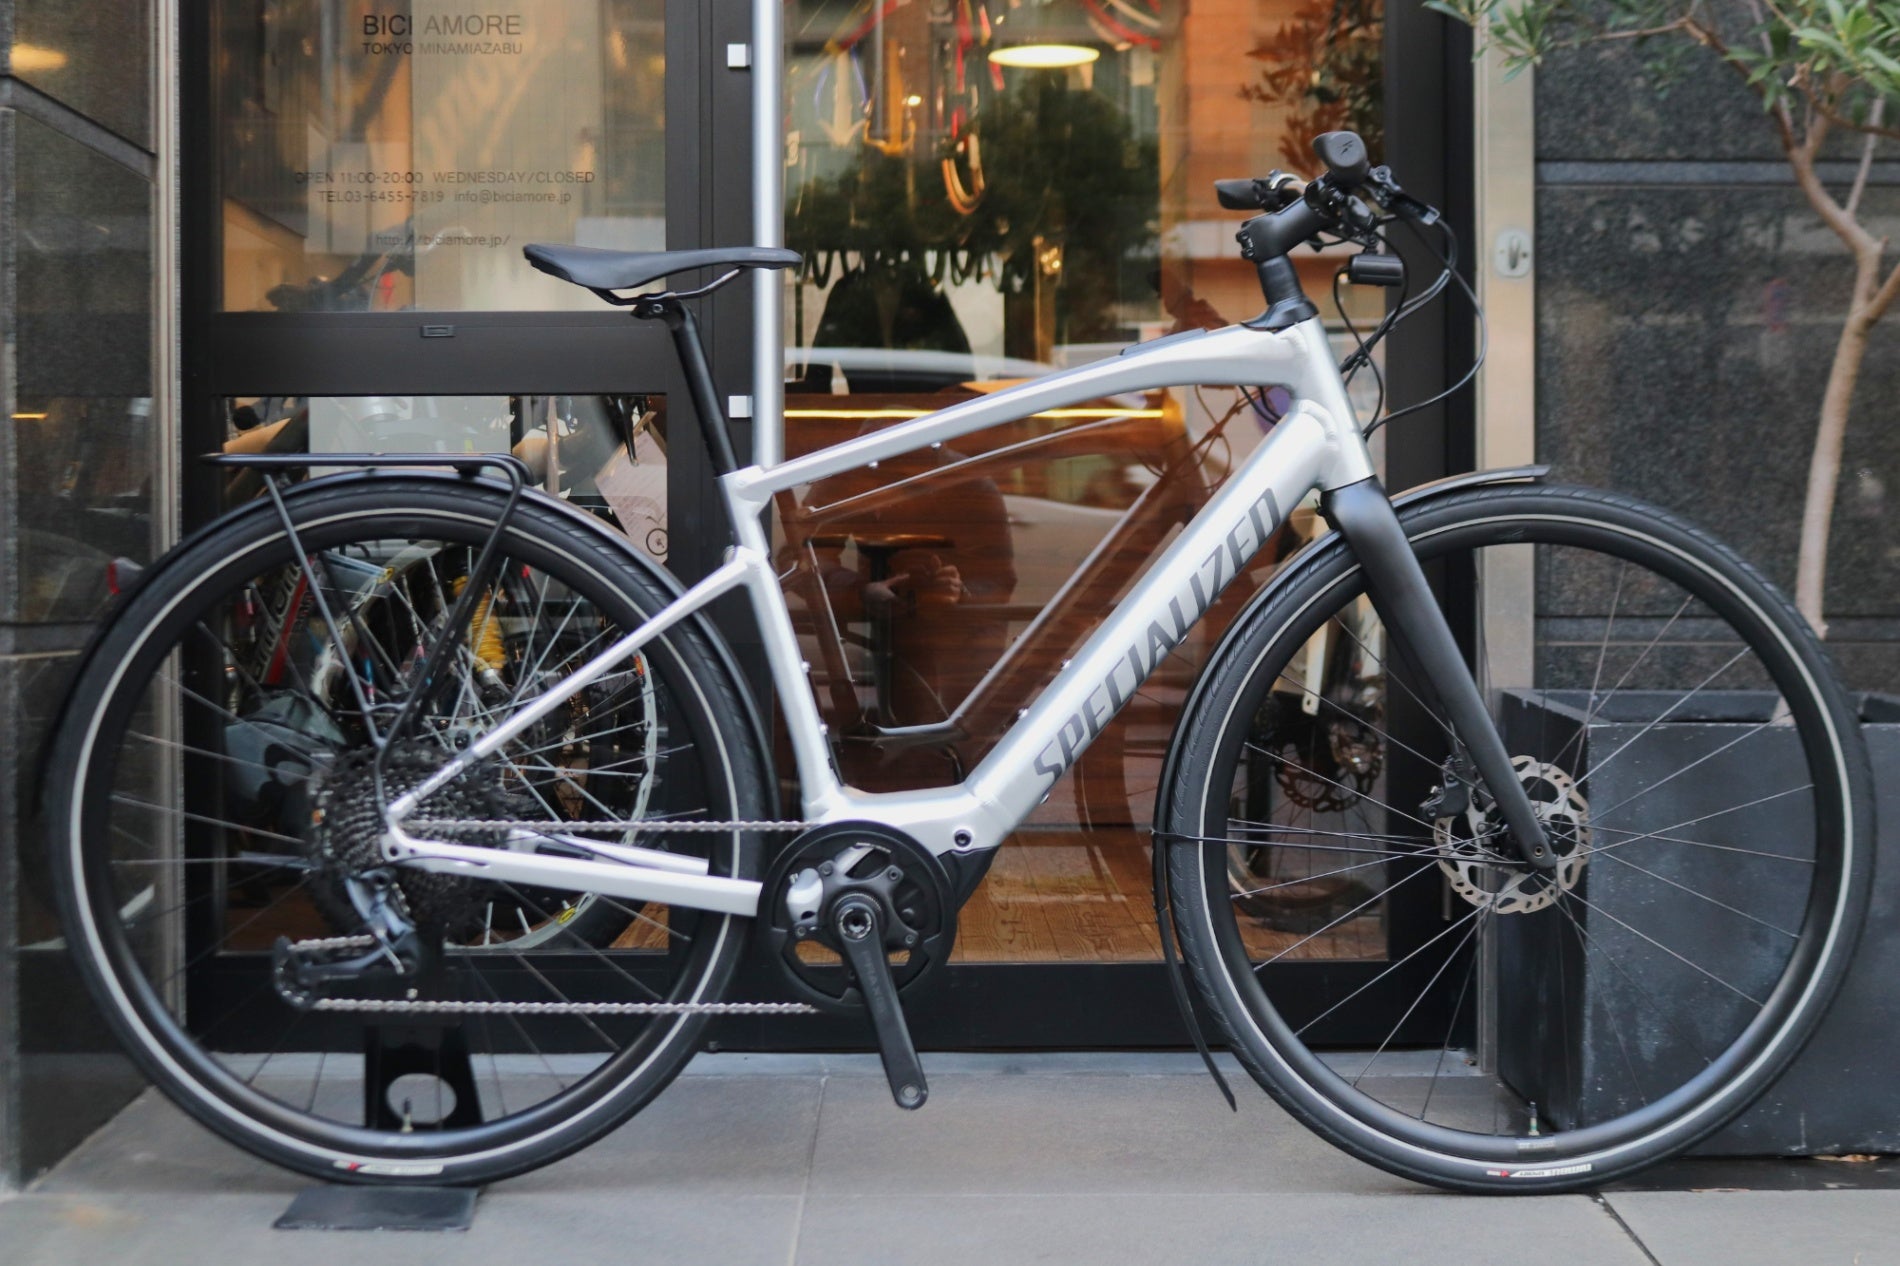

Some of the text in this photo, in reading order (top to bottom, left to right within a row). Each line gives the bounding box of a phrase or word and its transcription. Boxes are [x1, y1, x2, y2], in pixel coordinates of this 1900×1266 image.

[363, 15, 521, 36] BICI AMORE
[362, 43, 523, 54] TOKYO MINAMIAZABU
[295, 172, 334, 183] OPEN
[341, 172, 424, 183] 11:00-20:00
[454, 190, 572, 204] info@biciamore.jp
[1033, 487, 1281, 783] SPECIALIZED
